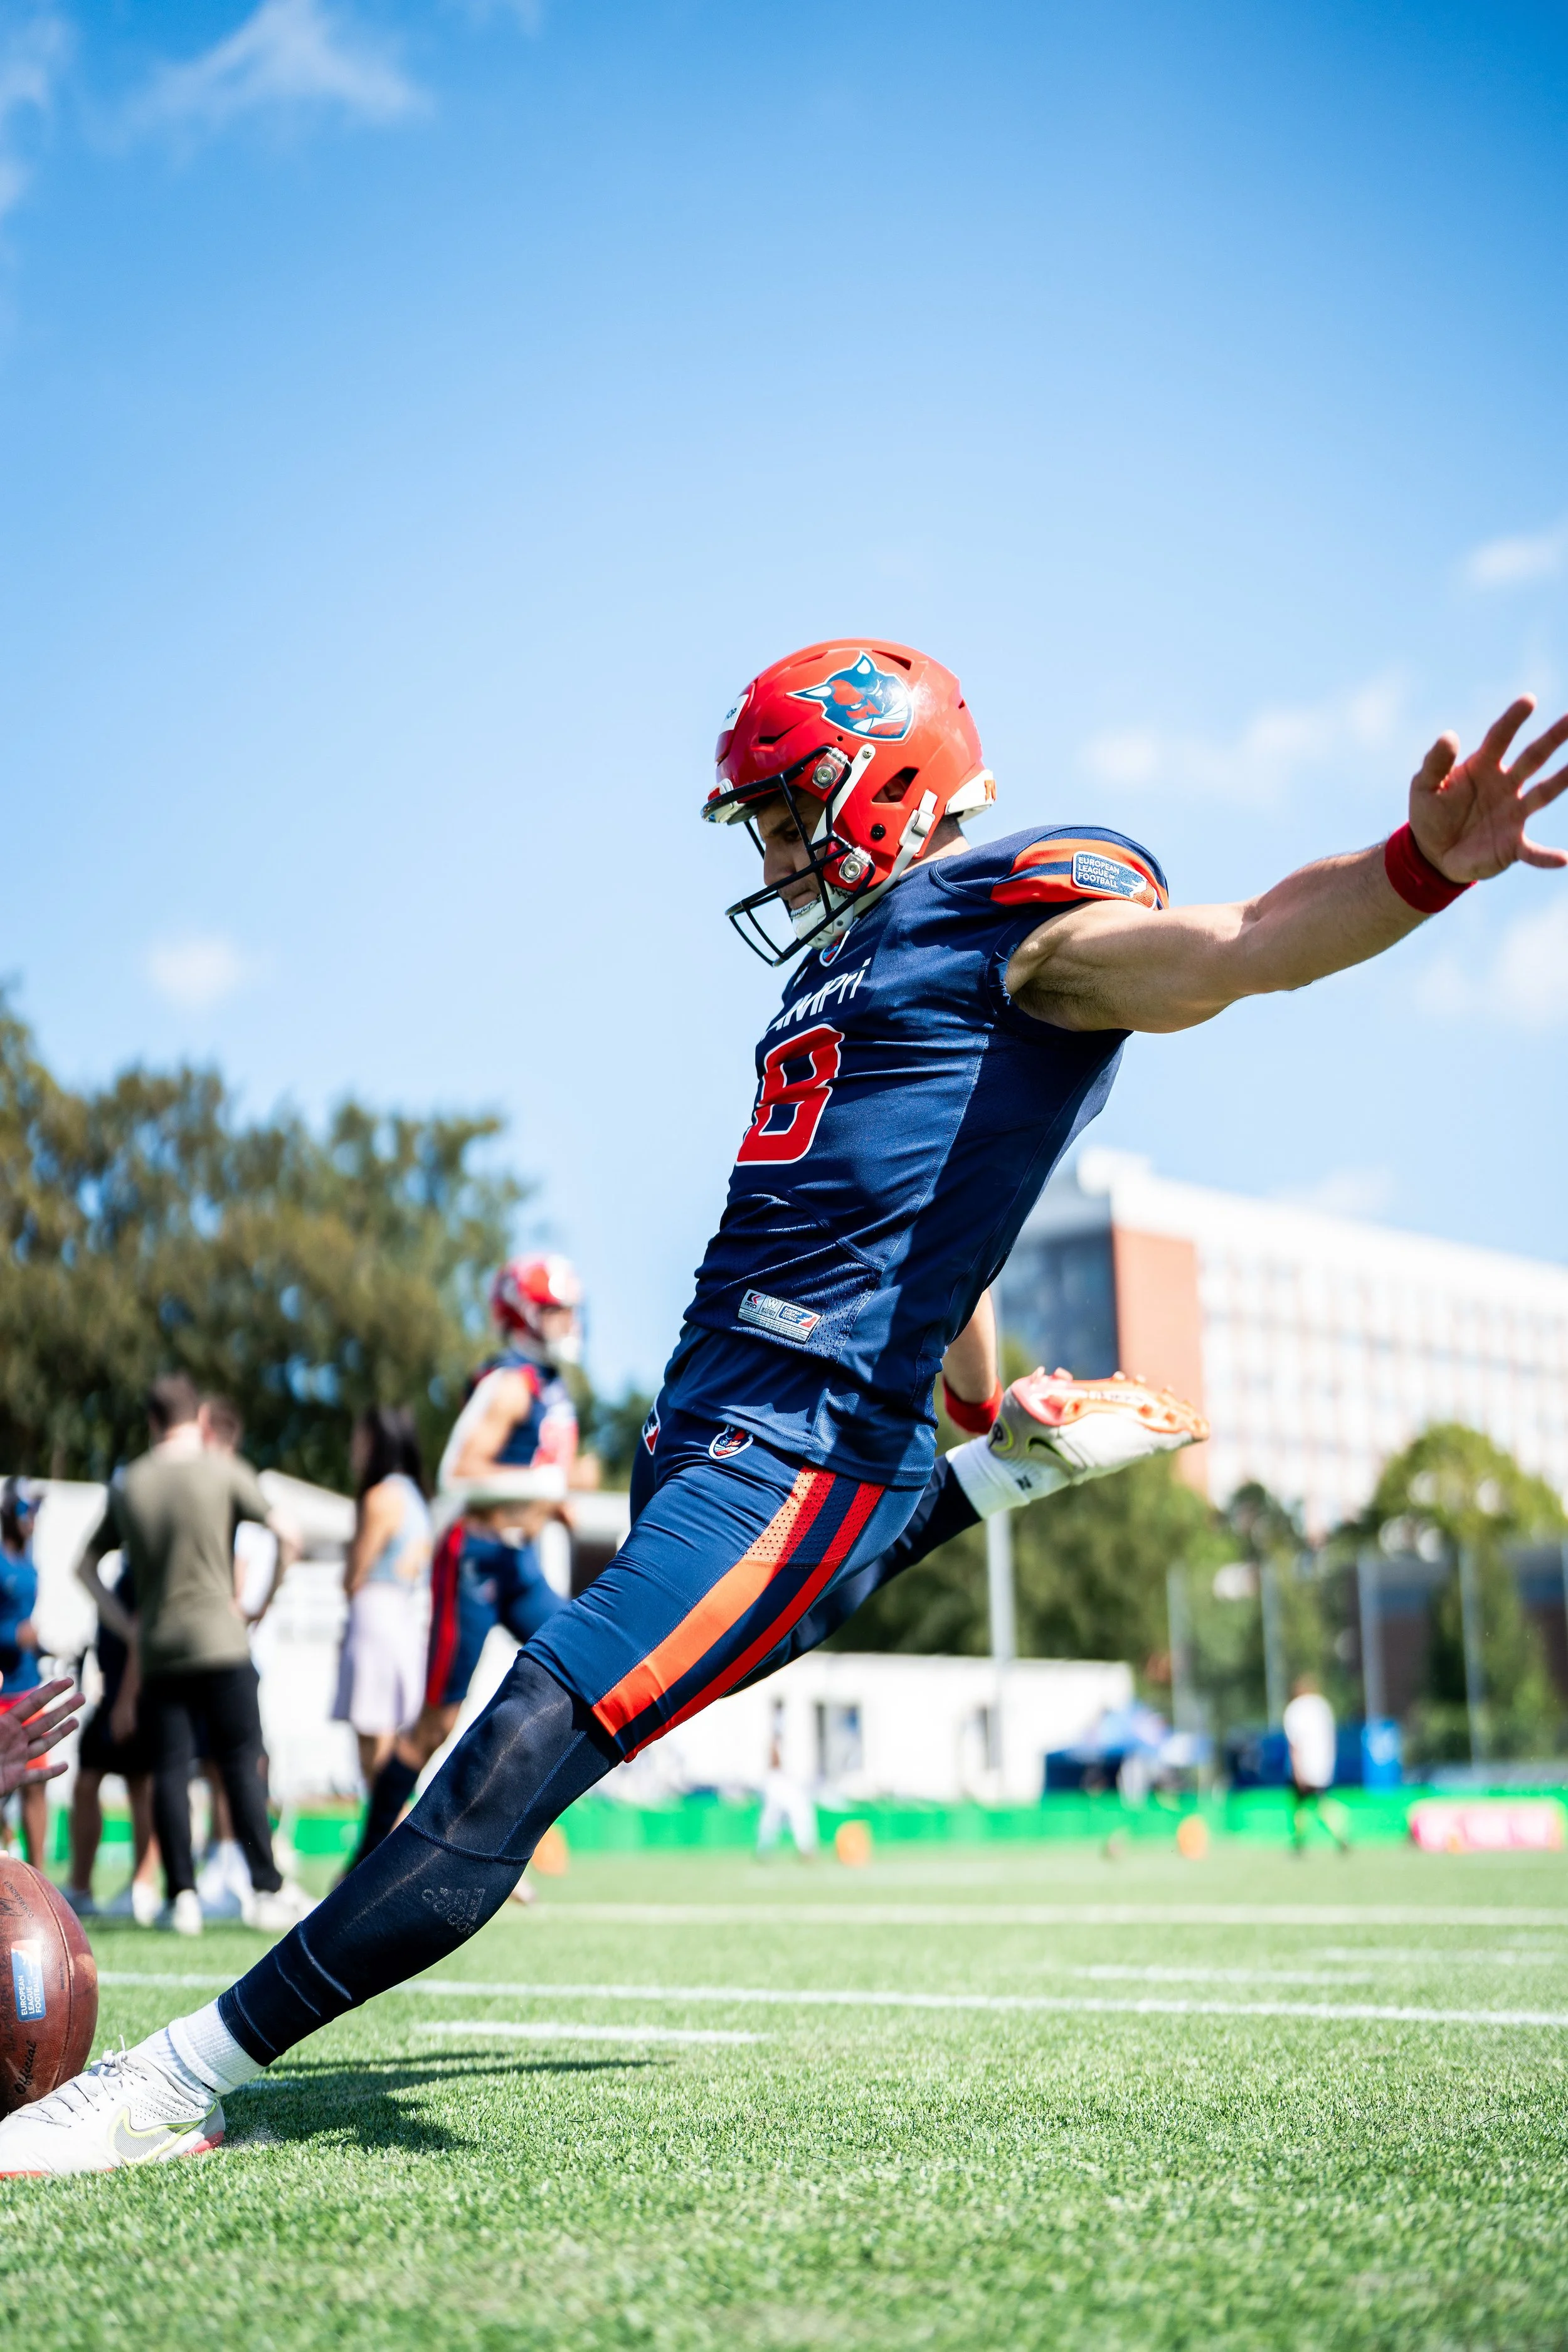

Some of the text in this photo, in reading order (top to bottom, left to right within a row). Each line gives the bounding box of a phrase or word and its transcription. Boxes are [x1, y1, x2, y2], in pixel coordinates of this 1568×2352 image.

[1078, 857, 1120, 874] EUROPEAN
[1078, 864, 1109, 879] LEAGUE
[1078, 872, 1118, 888] FOOTBALL
[735, 1024, 845, 1166] 8
[18, 1975, 28, 2016] EUROPEAN
[26, 1986, 34, 2014] LEAGUE
[33, 1976, 42, 2013] FOOTBALL
[14, 2040, 36, 2094] Official
